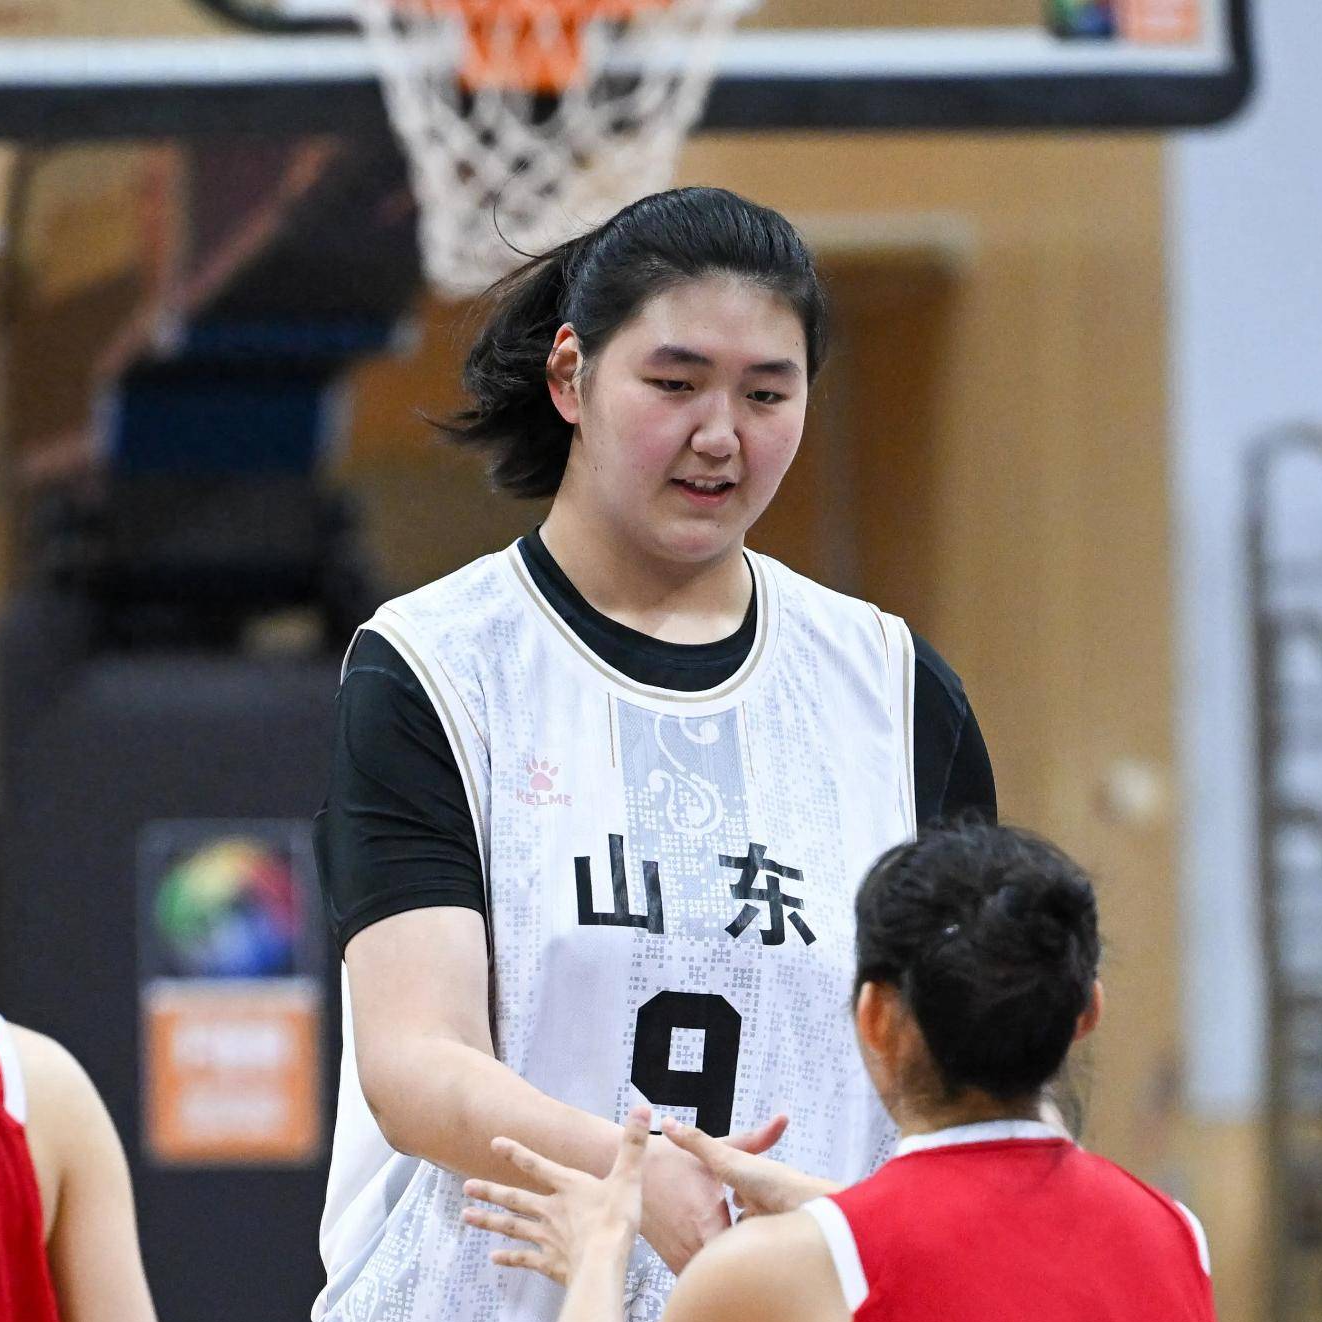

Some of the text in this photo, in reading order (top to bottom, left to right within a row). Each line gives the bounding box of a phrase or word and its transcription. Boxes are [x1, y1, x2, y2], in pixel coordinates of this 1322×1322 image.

[515, 788, 573, 808] KELME
[574, 833, 816, 946] 山东
[631, 990, 743, 1138] 9
